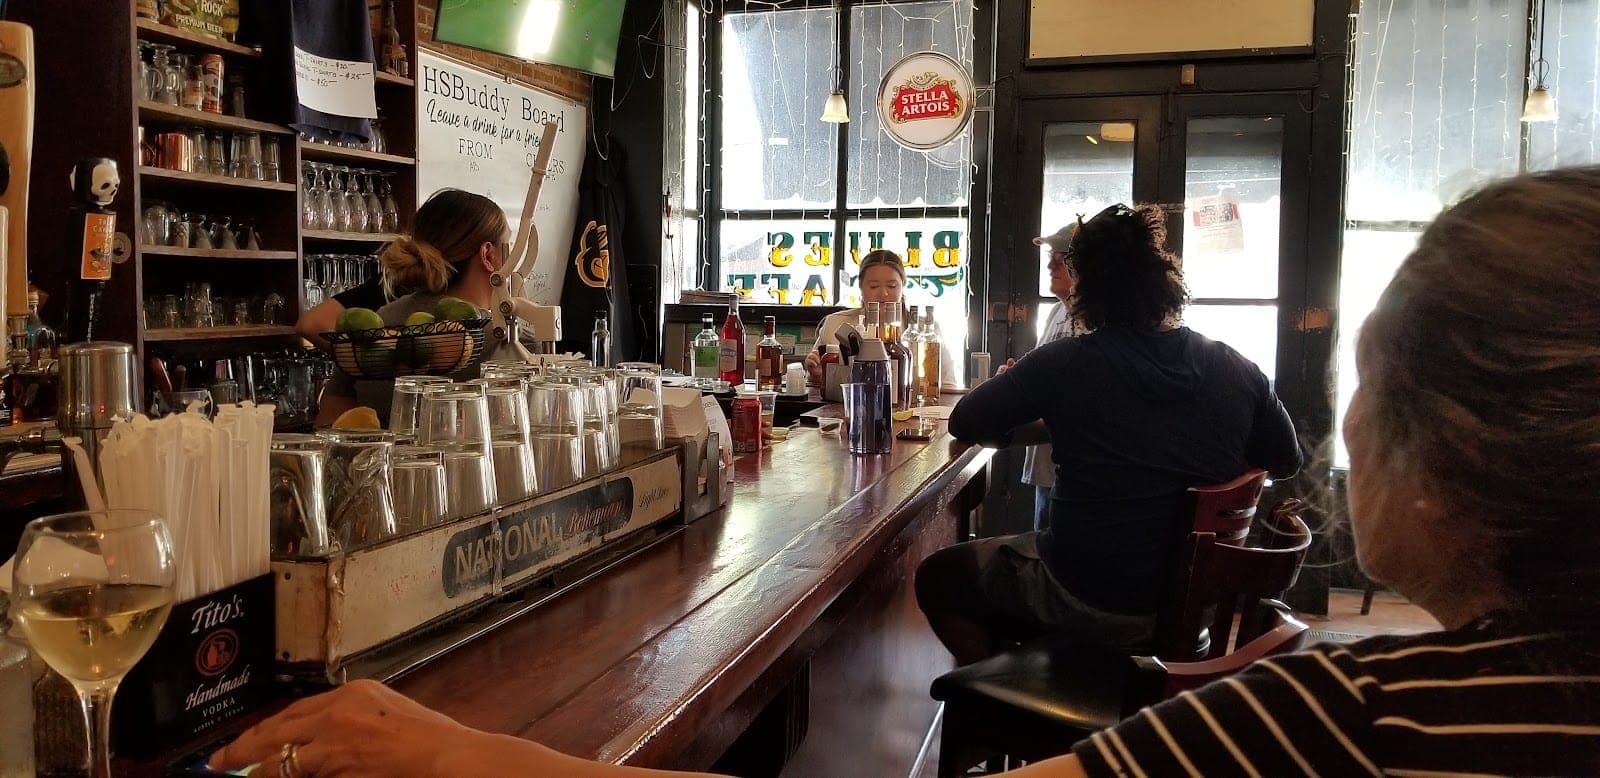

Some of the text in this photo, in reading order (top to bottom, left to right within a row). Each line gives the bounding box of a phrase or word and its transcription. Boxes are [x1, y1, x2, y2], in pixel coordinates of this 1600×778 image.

[201, 0, 224, 17] ROCK
[206, 22, 224, 34] BEER
[423, 65, 565, 133] HSBuddy Board
[901, 90, 949, 105] STELLA
[901, 101, 950, 116] ARTOIS
[426, 98, 543, 150] Leave a drink for a frie
[458, 138, 494, 161] FROM
[455, 499, 625, 582] NATONAL Bohemian
[191, 593, 245, 635] Tito's
[185, 663, 251, 712] Handmade
[202, 697, 236, 718] VODKA
